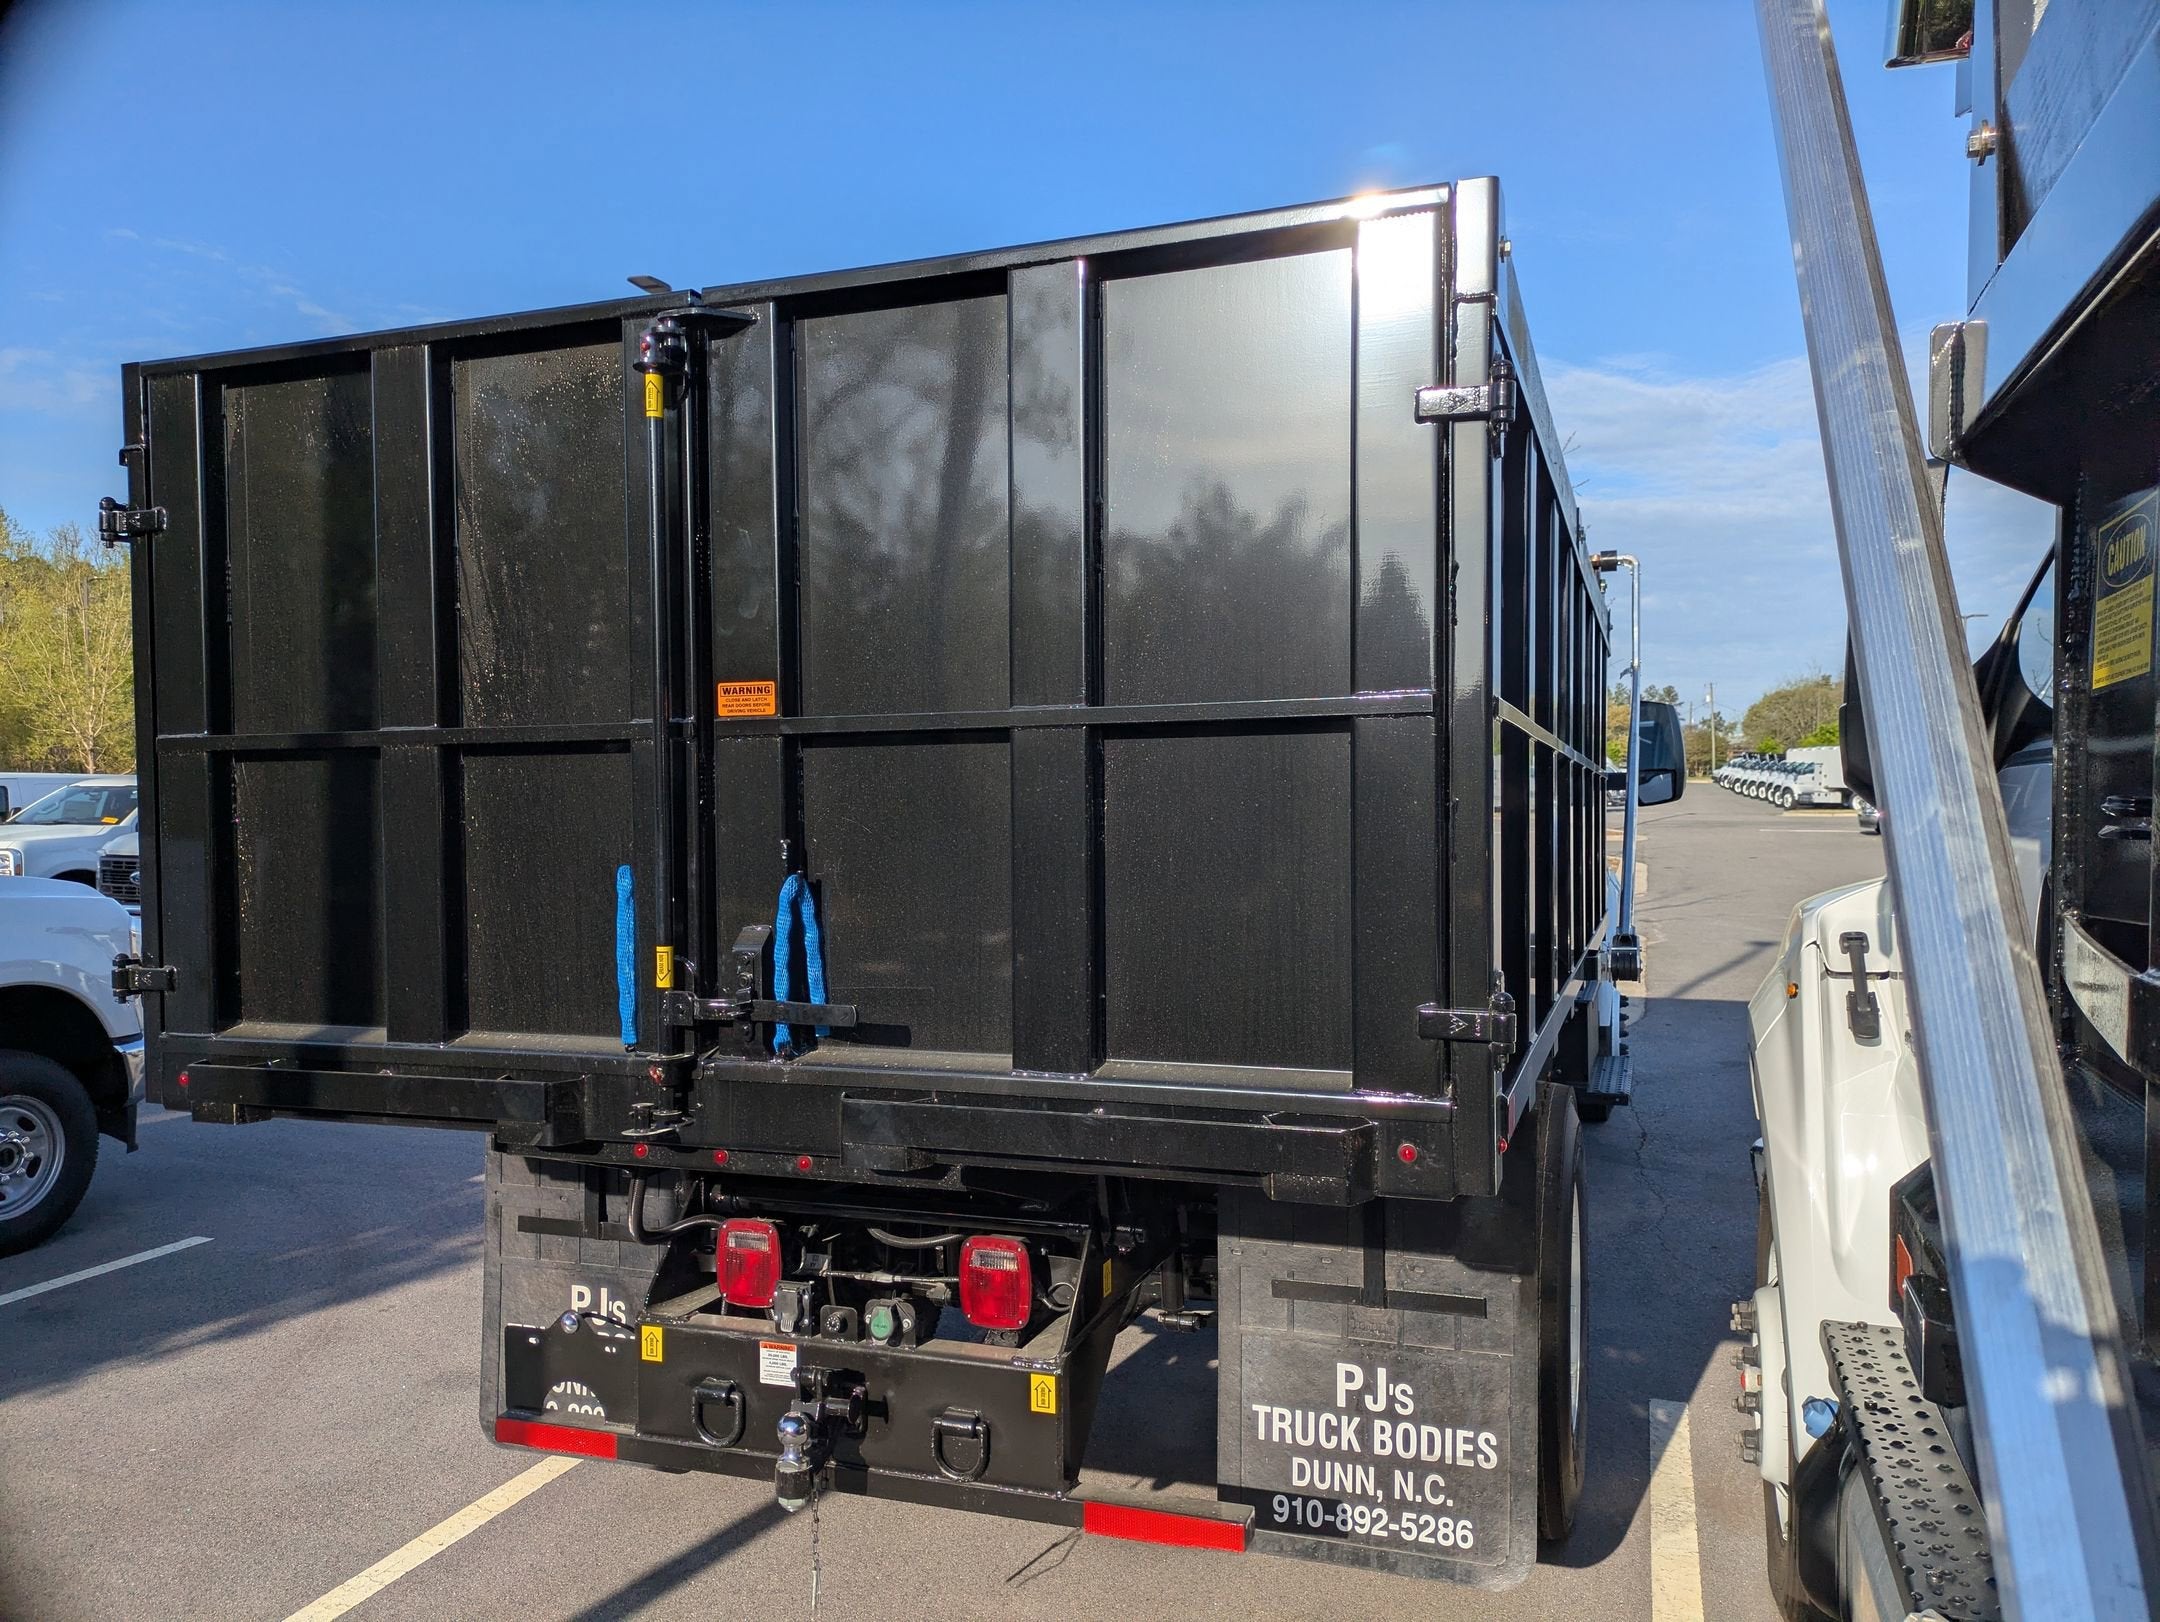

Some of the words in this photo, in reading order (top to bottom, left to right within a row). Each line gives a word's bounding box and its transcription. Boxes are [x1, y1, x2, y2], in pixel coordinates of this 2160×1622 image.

[2107, 523, 2146, 577] CAUTION
[722, 686, 770, 695] WARNING
[1336, 1362, 1415, 1416] PJ's
[1252, 1404, 1361, 1453] TRUCK
[1373, 1419, 1498, 1470] BODIES
[1292, 1456, 1383, 1504] DUNN,
[1394, 1469, 1454, 1507] N.C.
[1272, 1494, 1474, 1549] 910-892-5286
